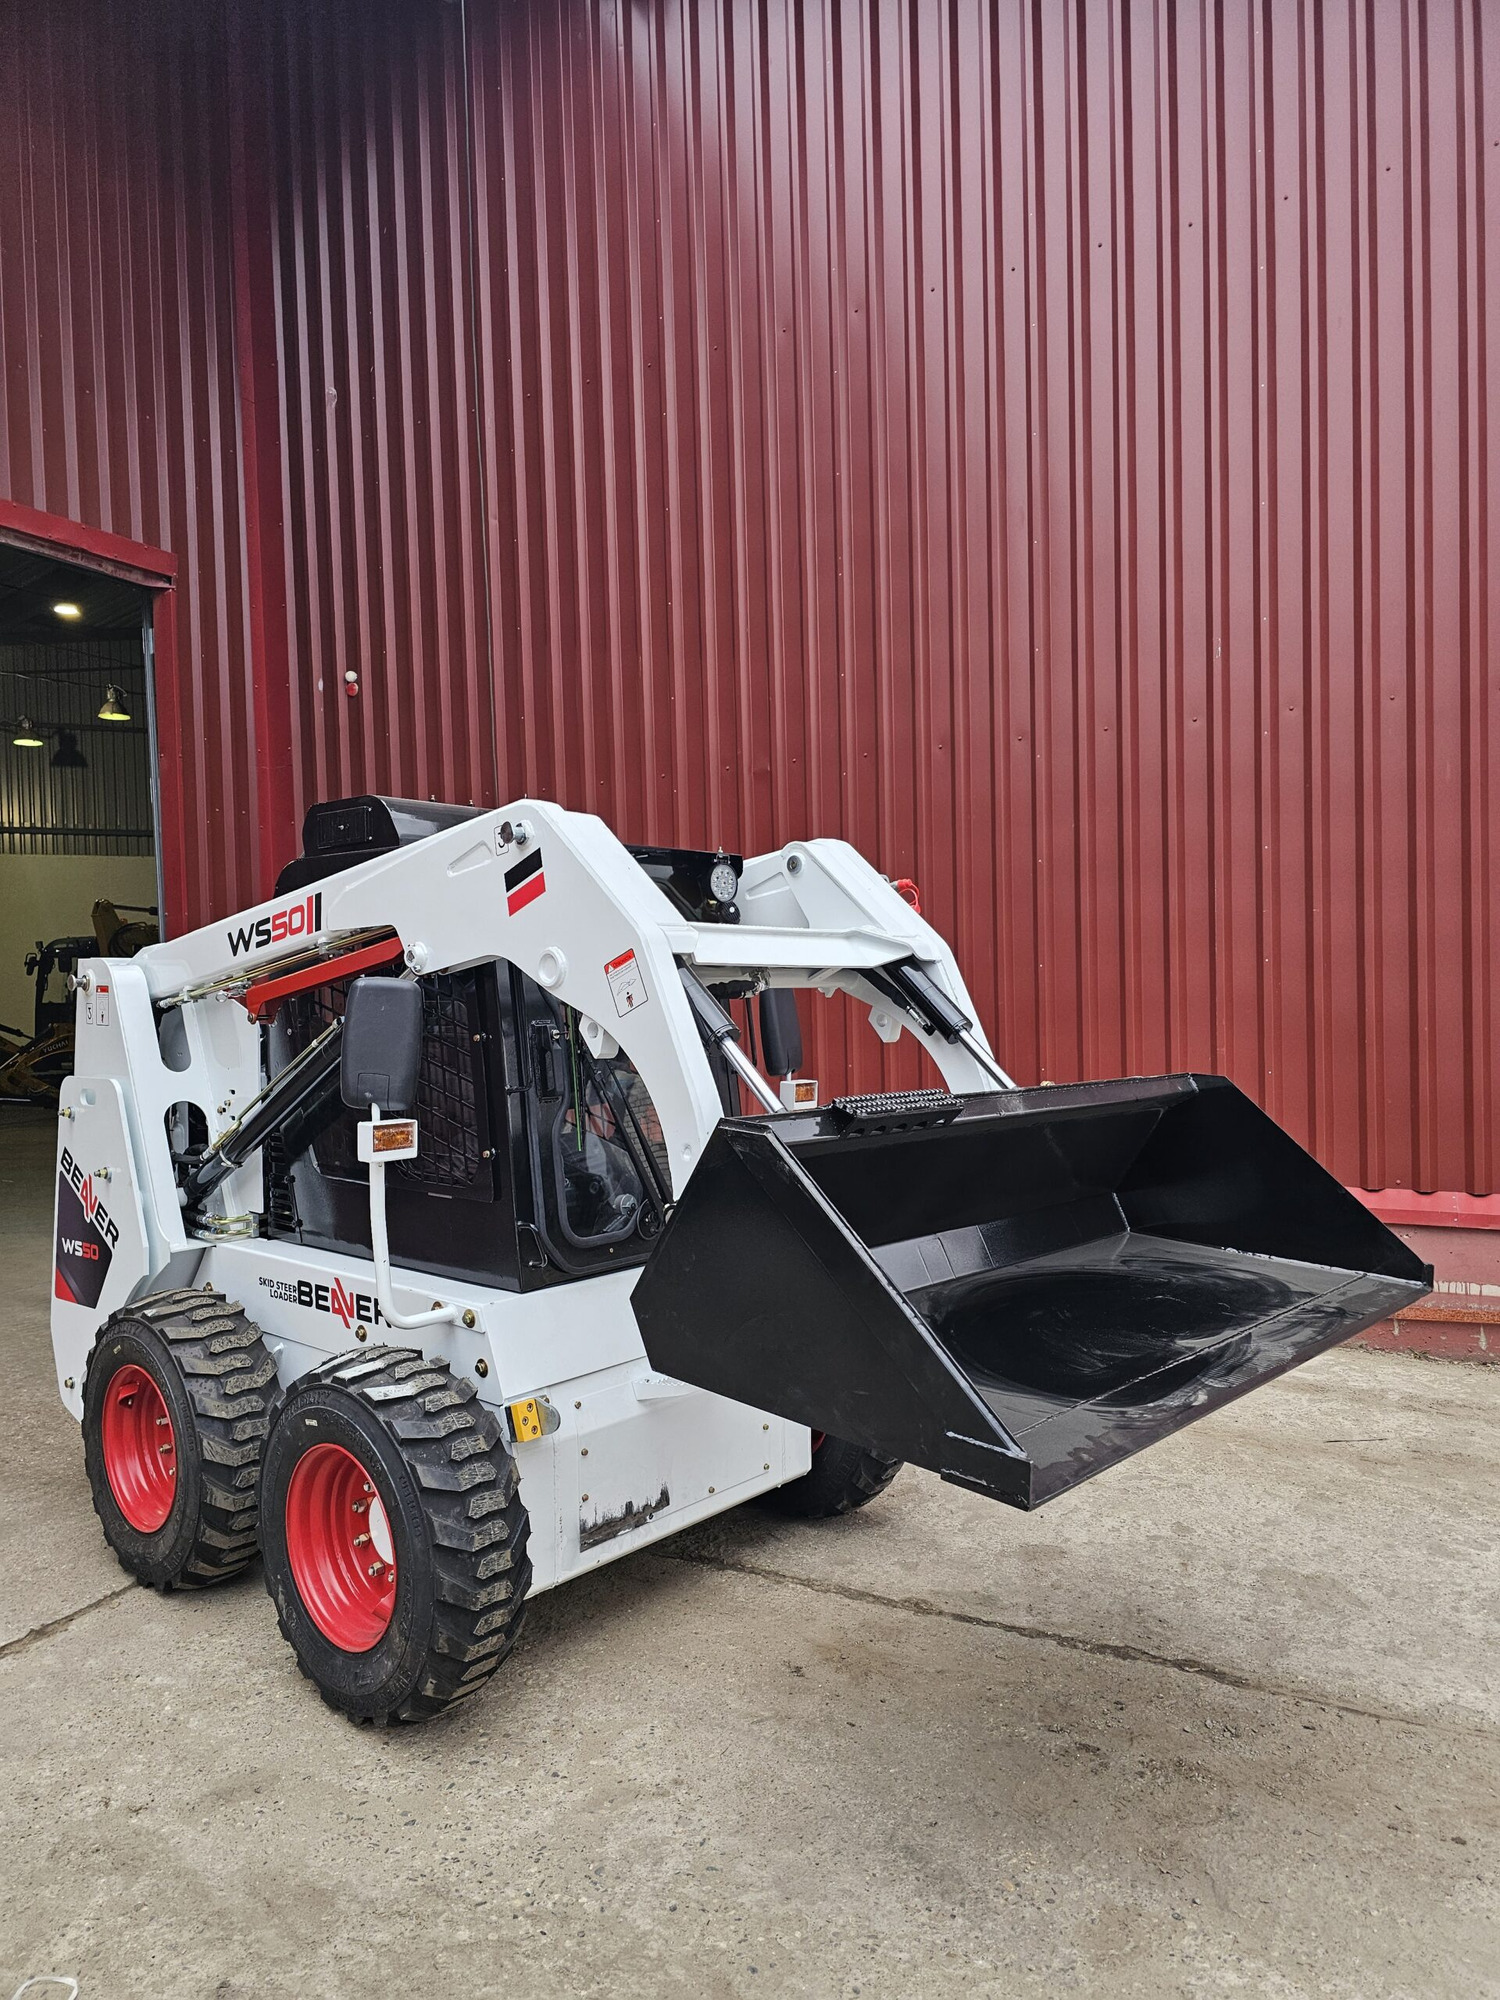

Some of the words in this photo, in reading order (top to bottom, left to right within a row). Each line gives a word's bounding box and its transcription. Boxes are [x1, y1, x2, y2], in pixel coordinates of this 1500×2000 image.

[43, 1040, 69, 1053] YUCHAI
[60, 1146, 119, 1249] BEAVER
[61, 1237, 99, 1260] WS50
[258, 1276, 275, 1289] SKID
[276, 1281, 297, 1295] STEER
[269, 1289, 298, 1304] LOADER
